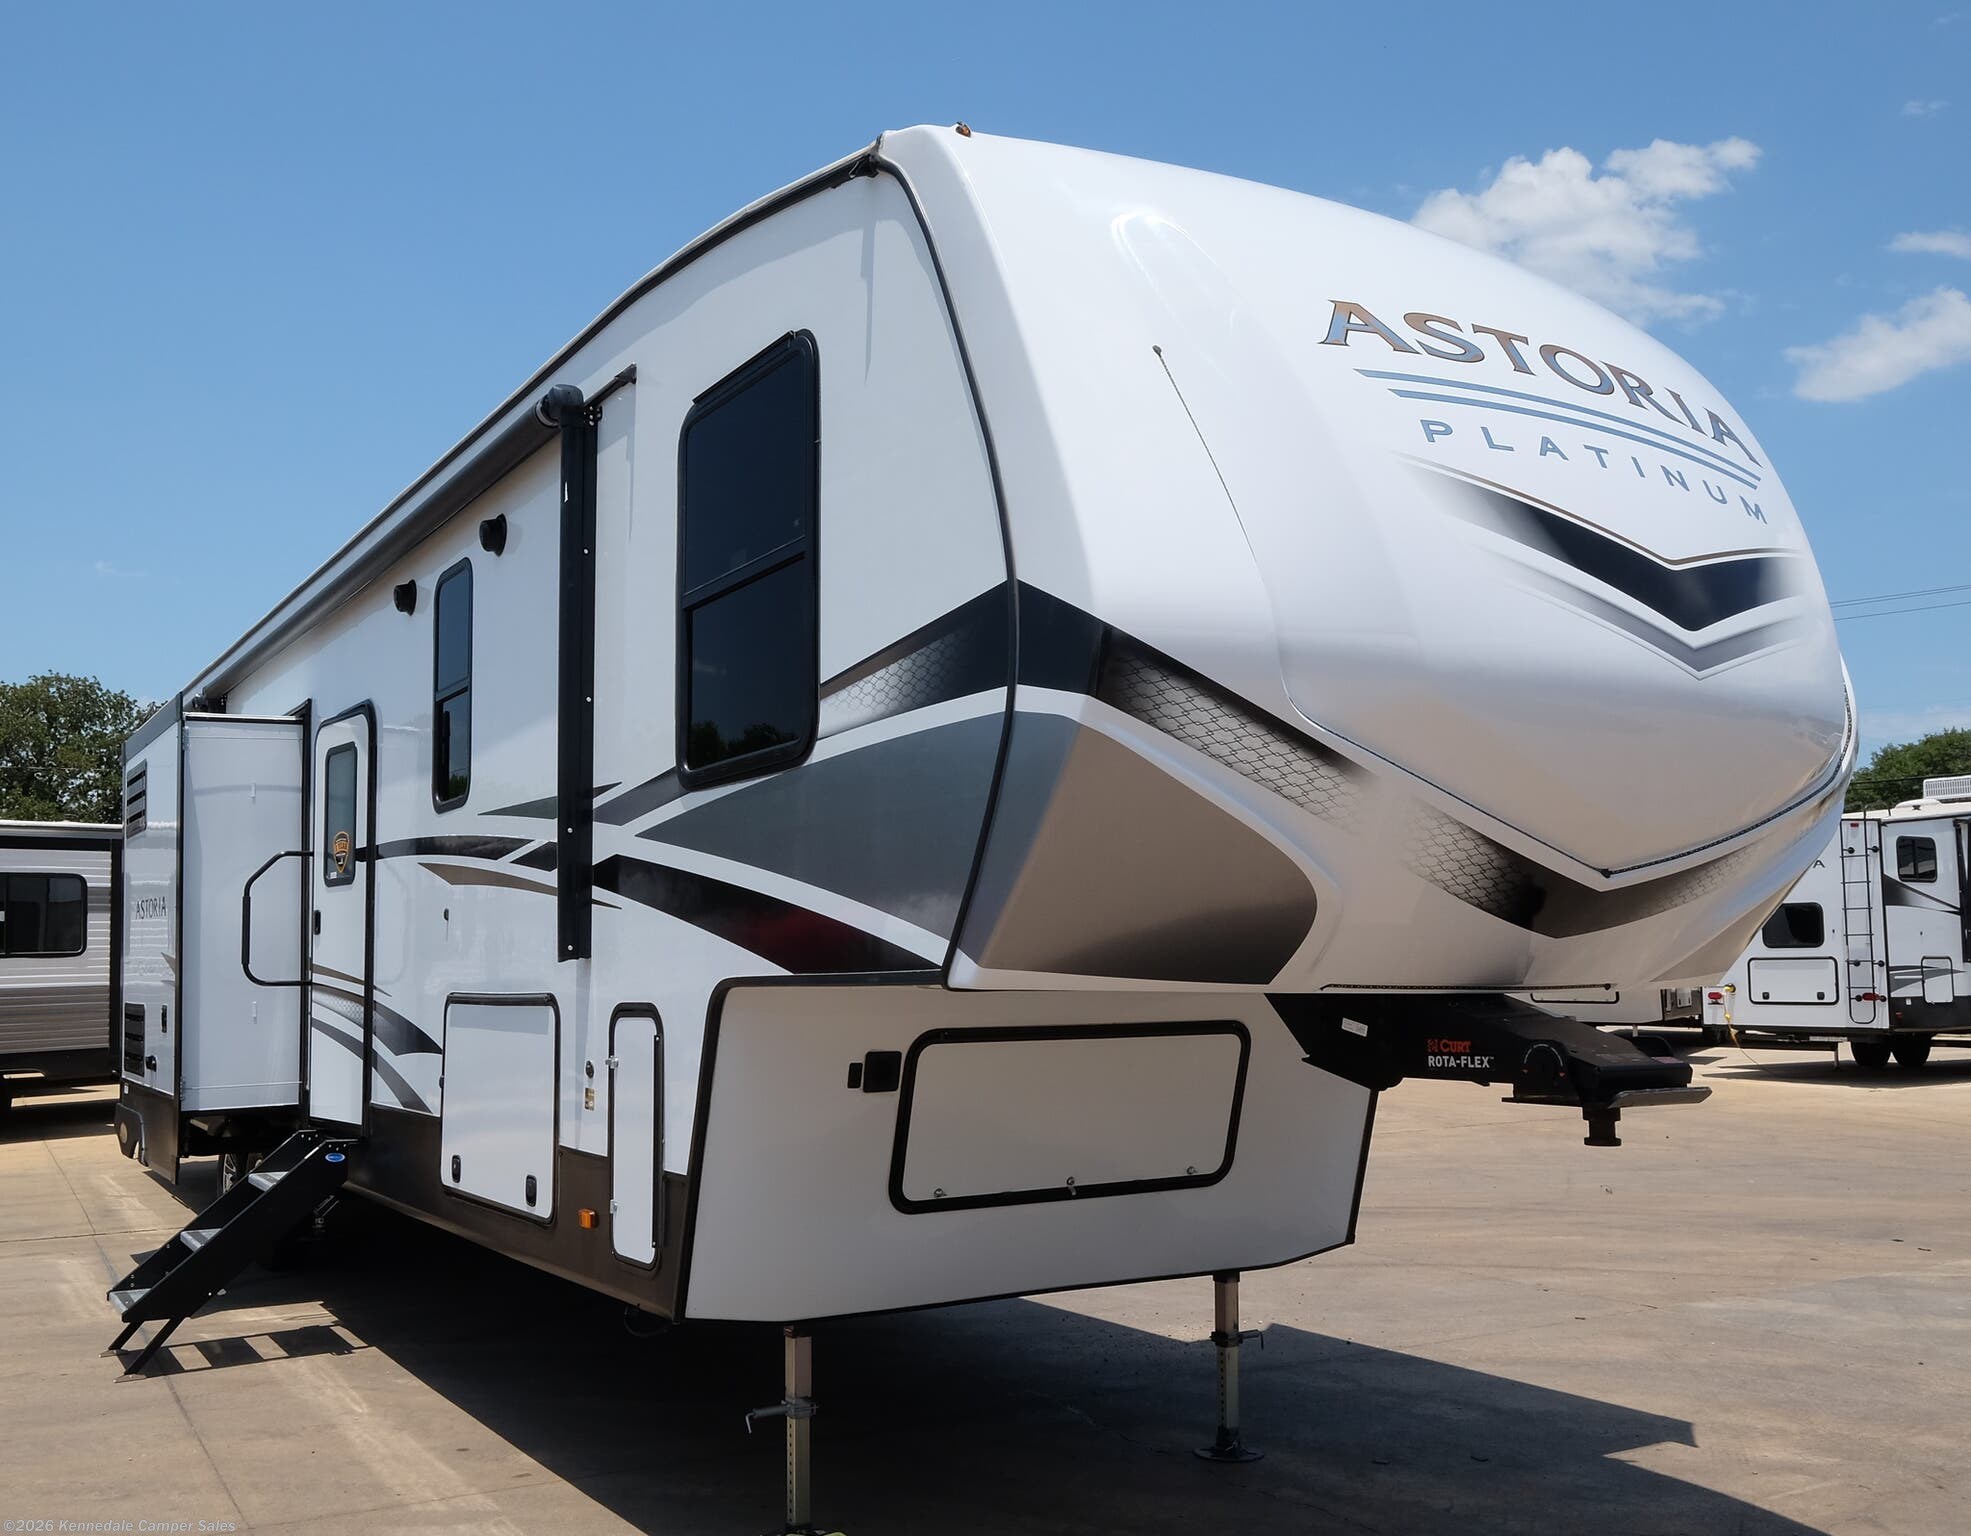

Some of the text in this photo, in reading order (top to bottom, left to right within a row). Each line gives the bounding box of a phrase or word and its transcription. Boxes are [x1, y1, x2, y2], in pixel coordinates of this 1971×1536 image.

[1319, 299, 1763, 467] ASTORIA
[1420, 419, 1768, 525] PLATINUM
[135, 896, 167, 920] ASTORIA
